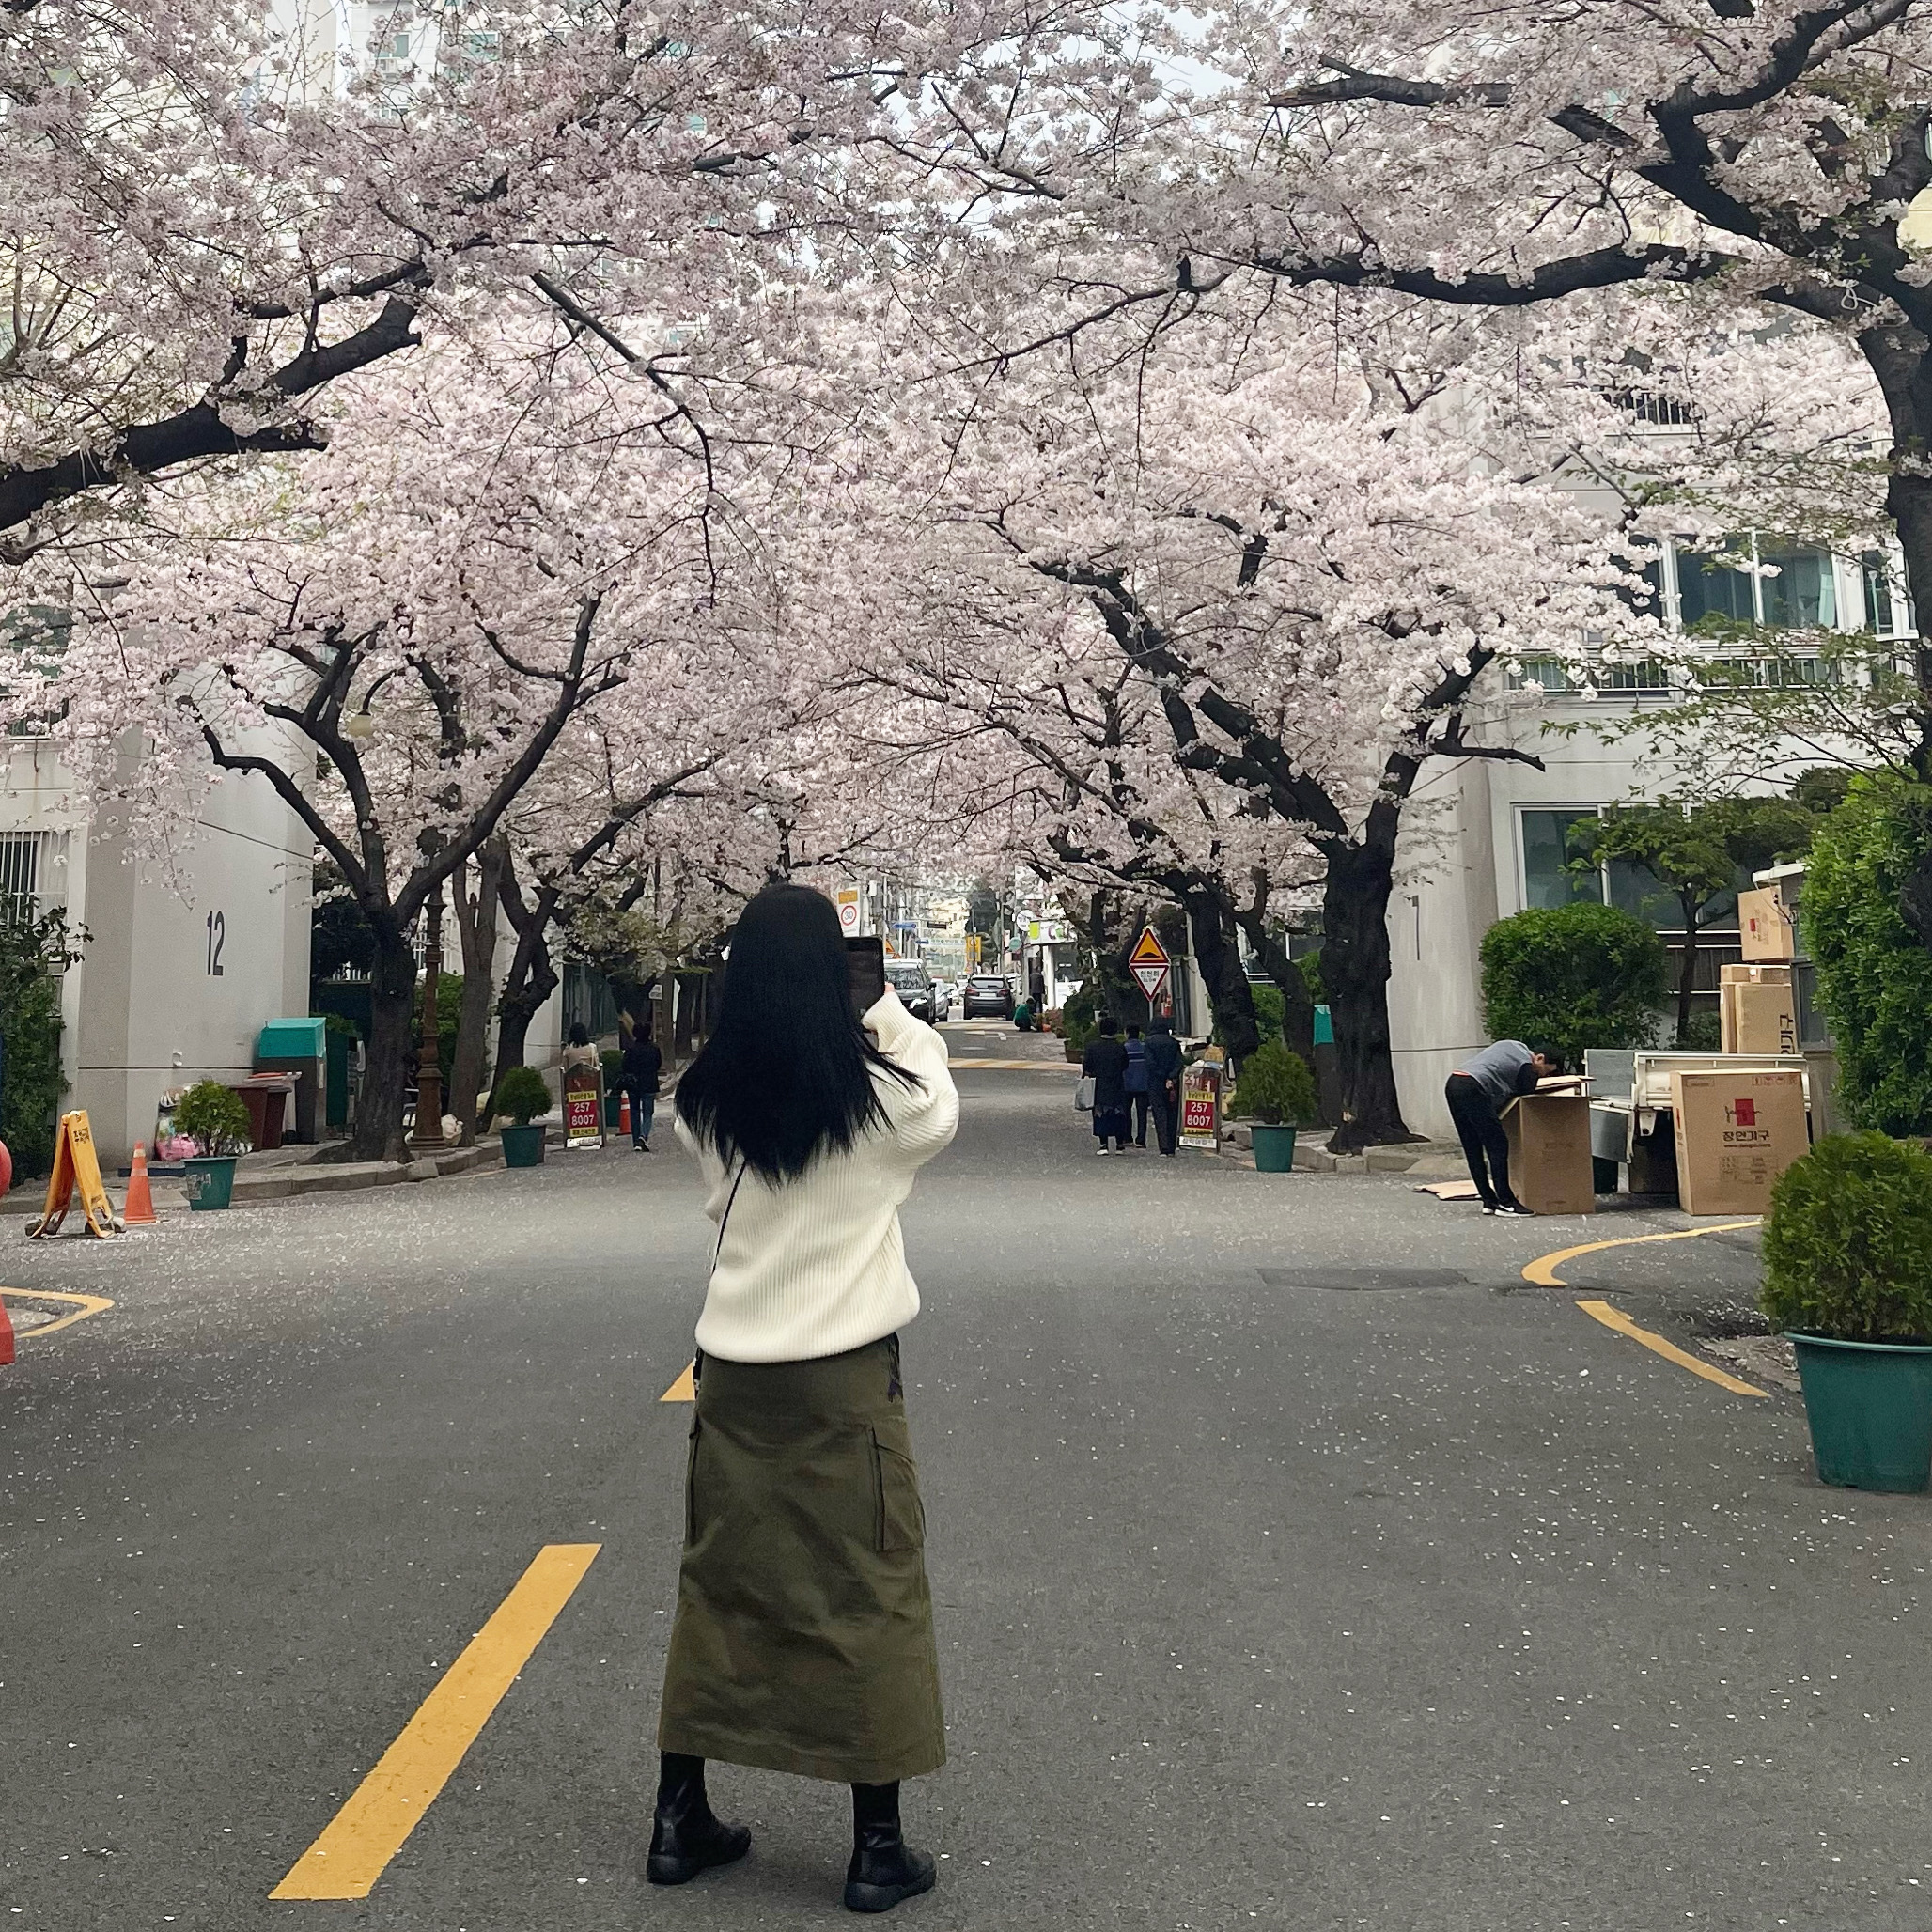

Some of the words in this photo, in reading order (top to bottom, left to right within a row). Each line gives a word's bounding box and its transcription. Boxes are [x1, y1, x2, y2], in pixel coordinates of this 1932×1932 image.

[844, 911, 854, 920] 30
[207, 910, 225, 976] 12
[573, 1101, 591, 1114] 257
[1190, 1101, 1208, 1114] 257
[571, 1114, 595, 1127] 8007
[1186, 1114, 1211, 1127] 8007
